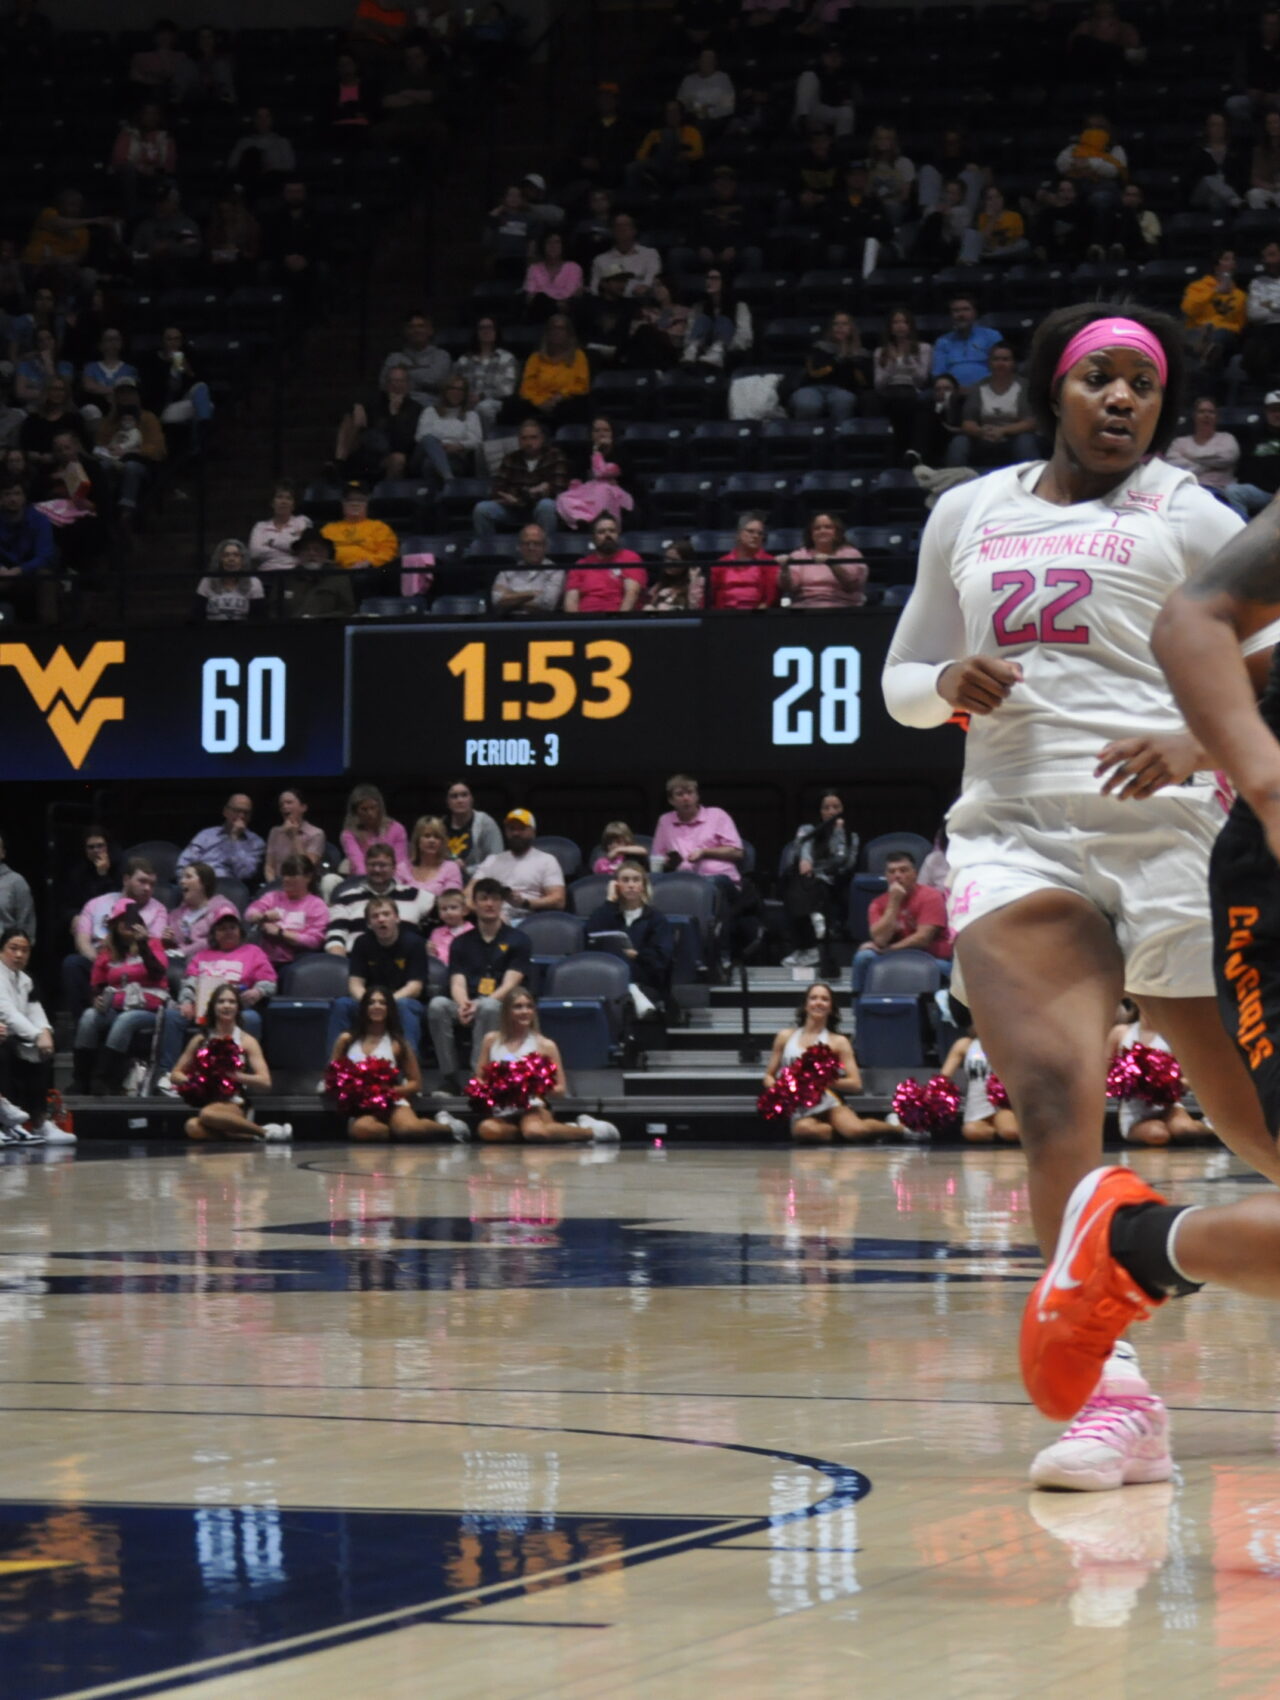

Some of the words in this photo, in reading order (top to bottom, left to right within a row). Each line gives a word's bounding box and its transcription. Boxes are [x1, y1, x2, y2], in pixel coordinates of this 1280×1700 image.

[976, 531, 1136, 566] MOUNTAINEERS
[992, 568, 1094, 647] 22
[202, 656, 286, 753] 60
[447, 640, 632, 721] 1:53
[772, 646, 861, 745] 28
[466, 738, 536, 766] PERIOD:
[543, 733, 560, 766] 3
